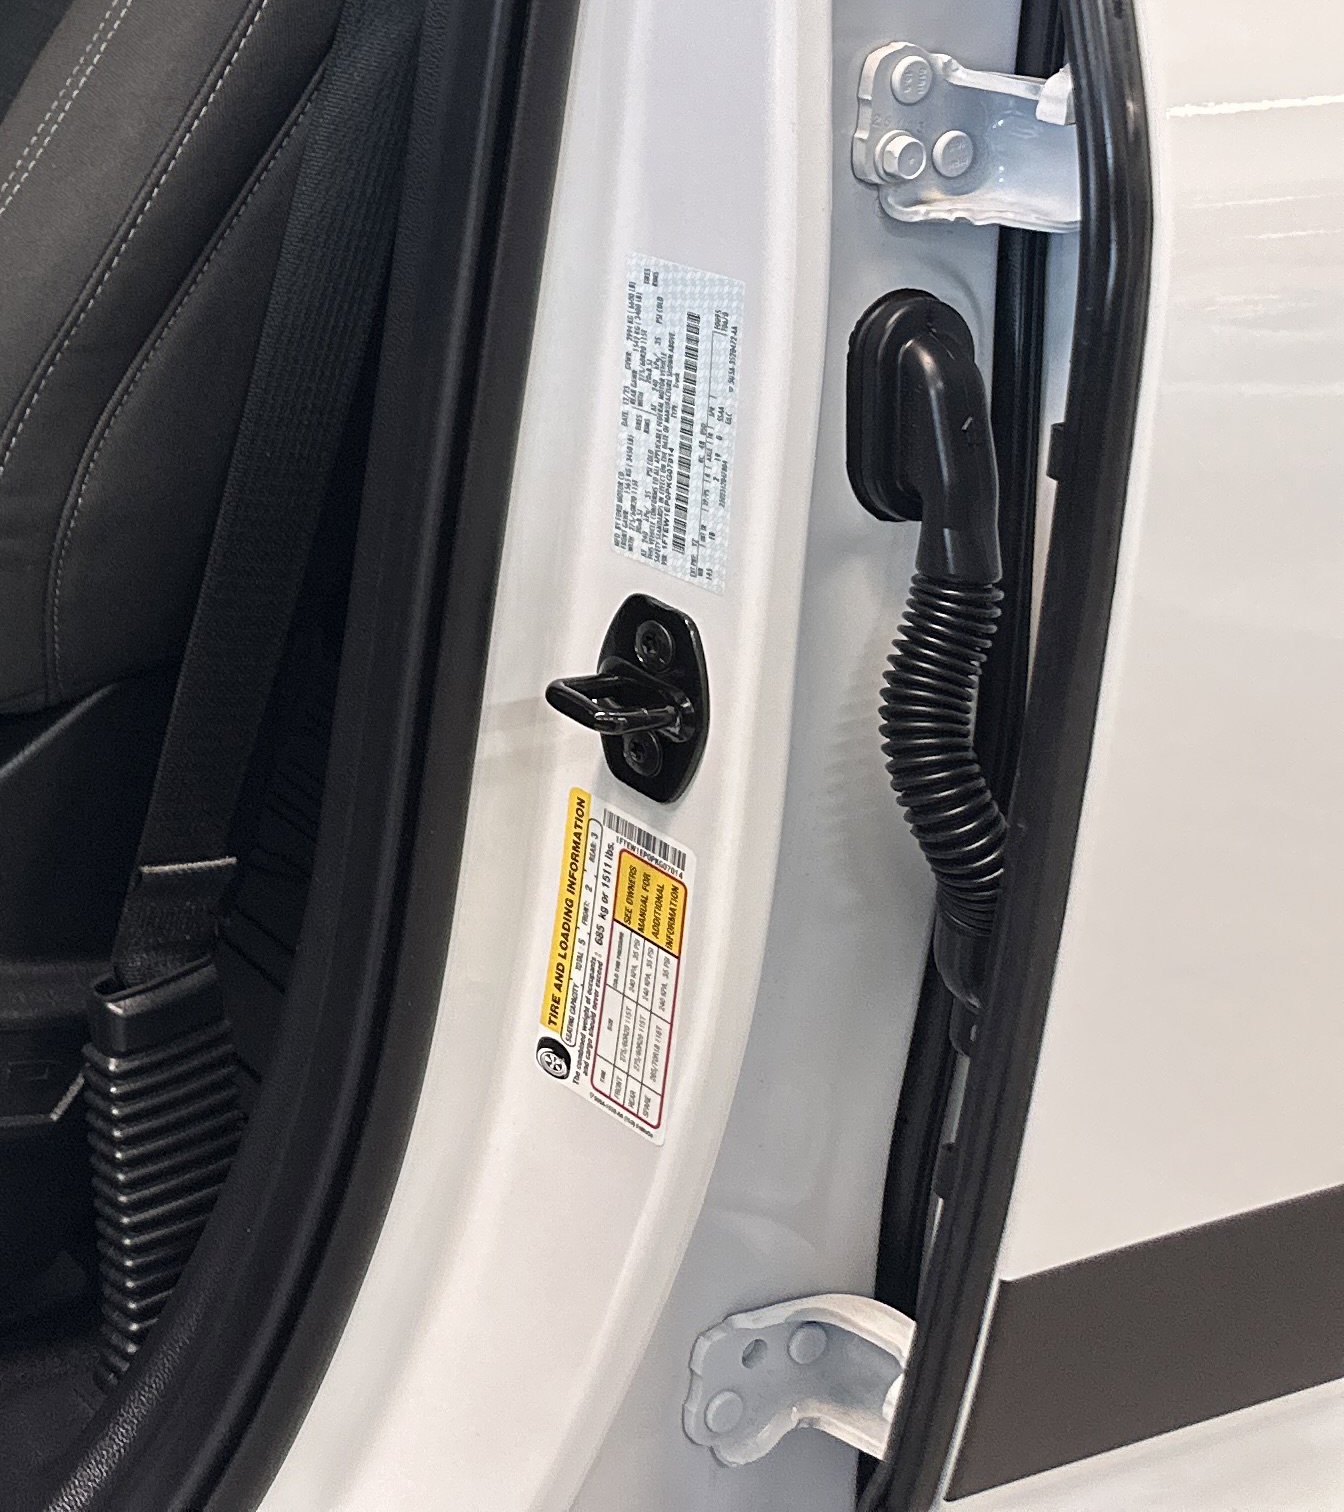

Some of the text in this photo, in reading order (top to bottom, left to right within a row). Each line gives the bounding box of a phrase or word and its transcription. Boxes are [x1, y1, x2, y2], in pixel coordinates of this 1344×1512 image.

[594, 838, 615, 947] 685 kg or 1511 lbs.
[623, 863, 637, 925] SEE OWNERS
[636, 871, 650, 933] MANUAL FOR
[651, 880, 664, 939] ADDITIONAL
[547, 795, 586, 1029] TIRE AND LOADING INFORMATION
[665, 883, 679, 951] INFORMATION
[586, 955, 597, 997] occupants
[594, 959, 603, 988] exceed
[569, 982, 579, 1015] CAPACITY
[565, 1014, 574, 1043] SEATING
[581, 1004, 591, 1033] weight
[587, 1009, 596, 1037] should
[575, 1031, 586, 1071] combined
[584, 1036, 593, 1061] cargo
[572, 1068, 580, 1086] The
[614, 1074, 622, 1100] FRONT
